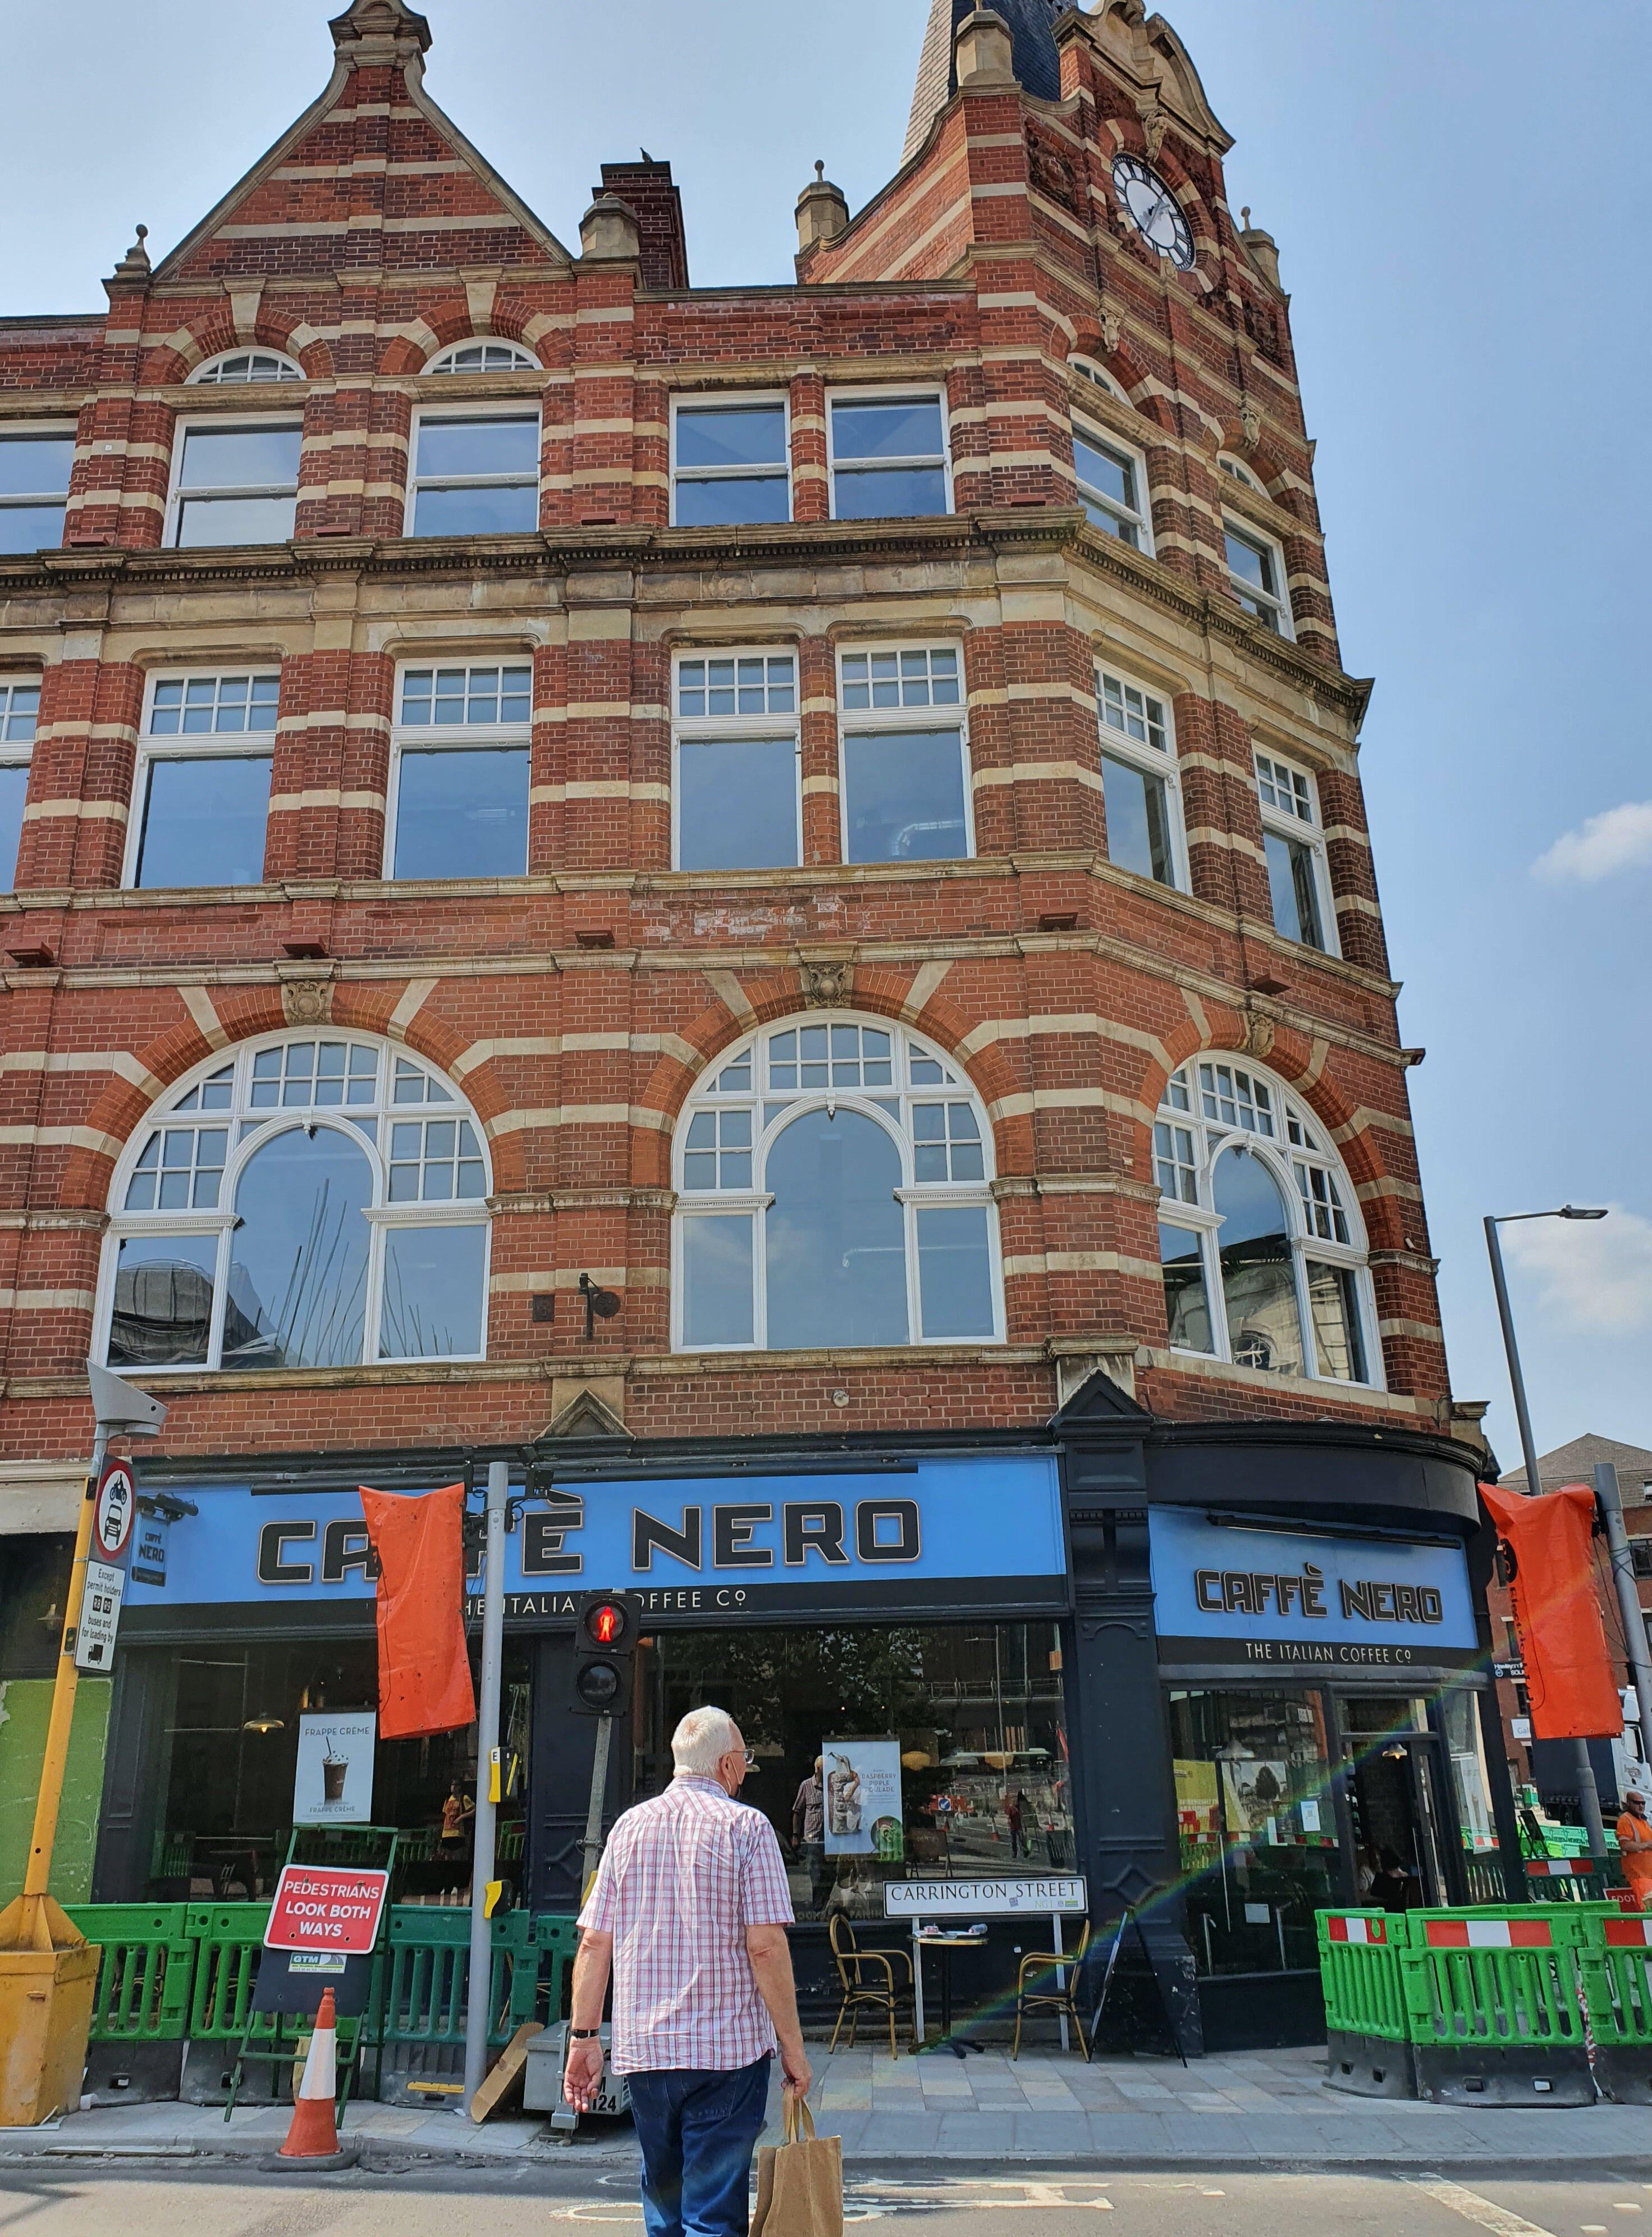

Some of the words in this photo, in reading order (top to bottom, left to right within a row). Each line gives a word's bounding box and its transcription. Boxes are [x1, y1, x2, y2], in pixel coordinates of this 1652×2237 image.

[257, 1489, 584, 1583] CAFÈ
[631, 1499, 922, 1572] NERO
[139, 1544, 164, 1563] NERO
[98, 1568, 115, 1582] Except
[87, 1581, 103, 1592] permit
[104, 1583, 121, 1597] holders
[1195, 1562, 1328, 1617] CAFFÈ
[1341, 1578, 1443, 1624] NERO
[465, 1599, 485, 1615] HE
[503, 1596, 575, 1615] ITALIA
[638, 1591, 702, 1609] FFEE
[88, 1614, 102, 1627] buses
[102, 1619, 112, 1629] and
[90, 1629, 107, 1643] loading
[108, 1633, 114, 1644] by
[1246, 1642, 1272, 1659] THE
[1280, 1644, 1334, 1661] ITALIAN
[1340, 1647, 1389, 1663] COFFEE
[305, 1728, 337, 1736] FRAPPE
[493, 1752, 497, 1761] E
[283, 1880, 380, 1900] PEDESTRIANS
[891, 1884, 1007, 1901] CARRINGTON
[1016, 1882, 1077, 1897] STREET
[285, 1901, 328, 1917] LOOK
[330, 1905, 371, 1919] BOTH
[299, 1921, 343, 1937] WAYS
[293, 1955, 319, 1964] GTM
